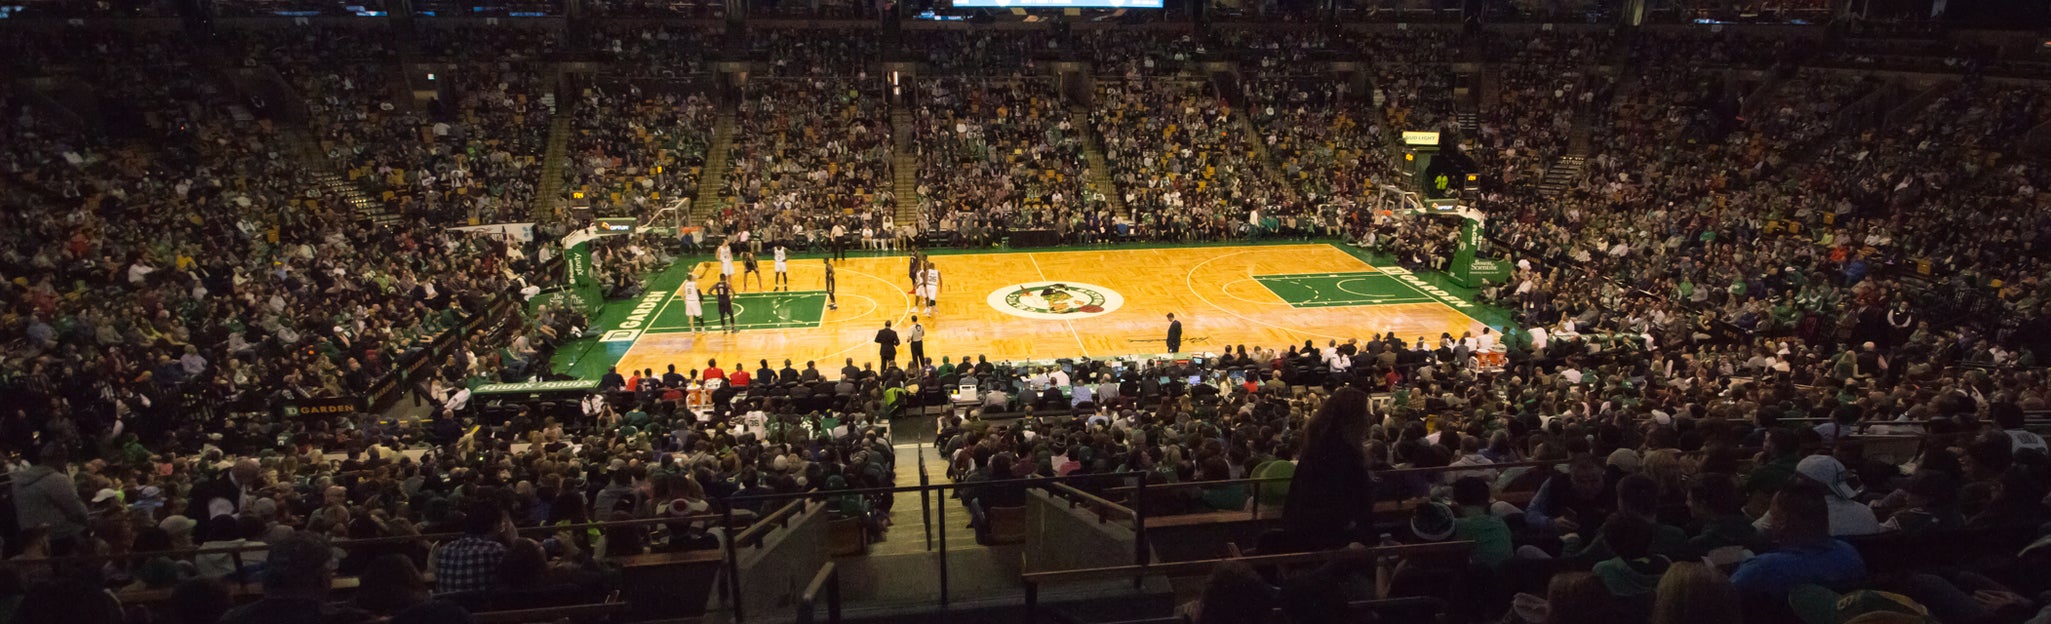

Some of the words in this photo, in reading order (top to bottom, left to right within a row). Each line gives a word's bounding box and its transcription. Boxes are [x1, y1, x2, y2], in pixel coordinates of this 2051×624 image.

[575, 253, 584, 276] xfinity
[1400, 275, 1475, 307] GARDEN
[619, 291, 668, 329] GARDEN
[479, 382, 536, 392] xfinity
[540, 380, 594, 390] xfinity
[300, 404, 354, 415] GARDEN
